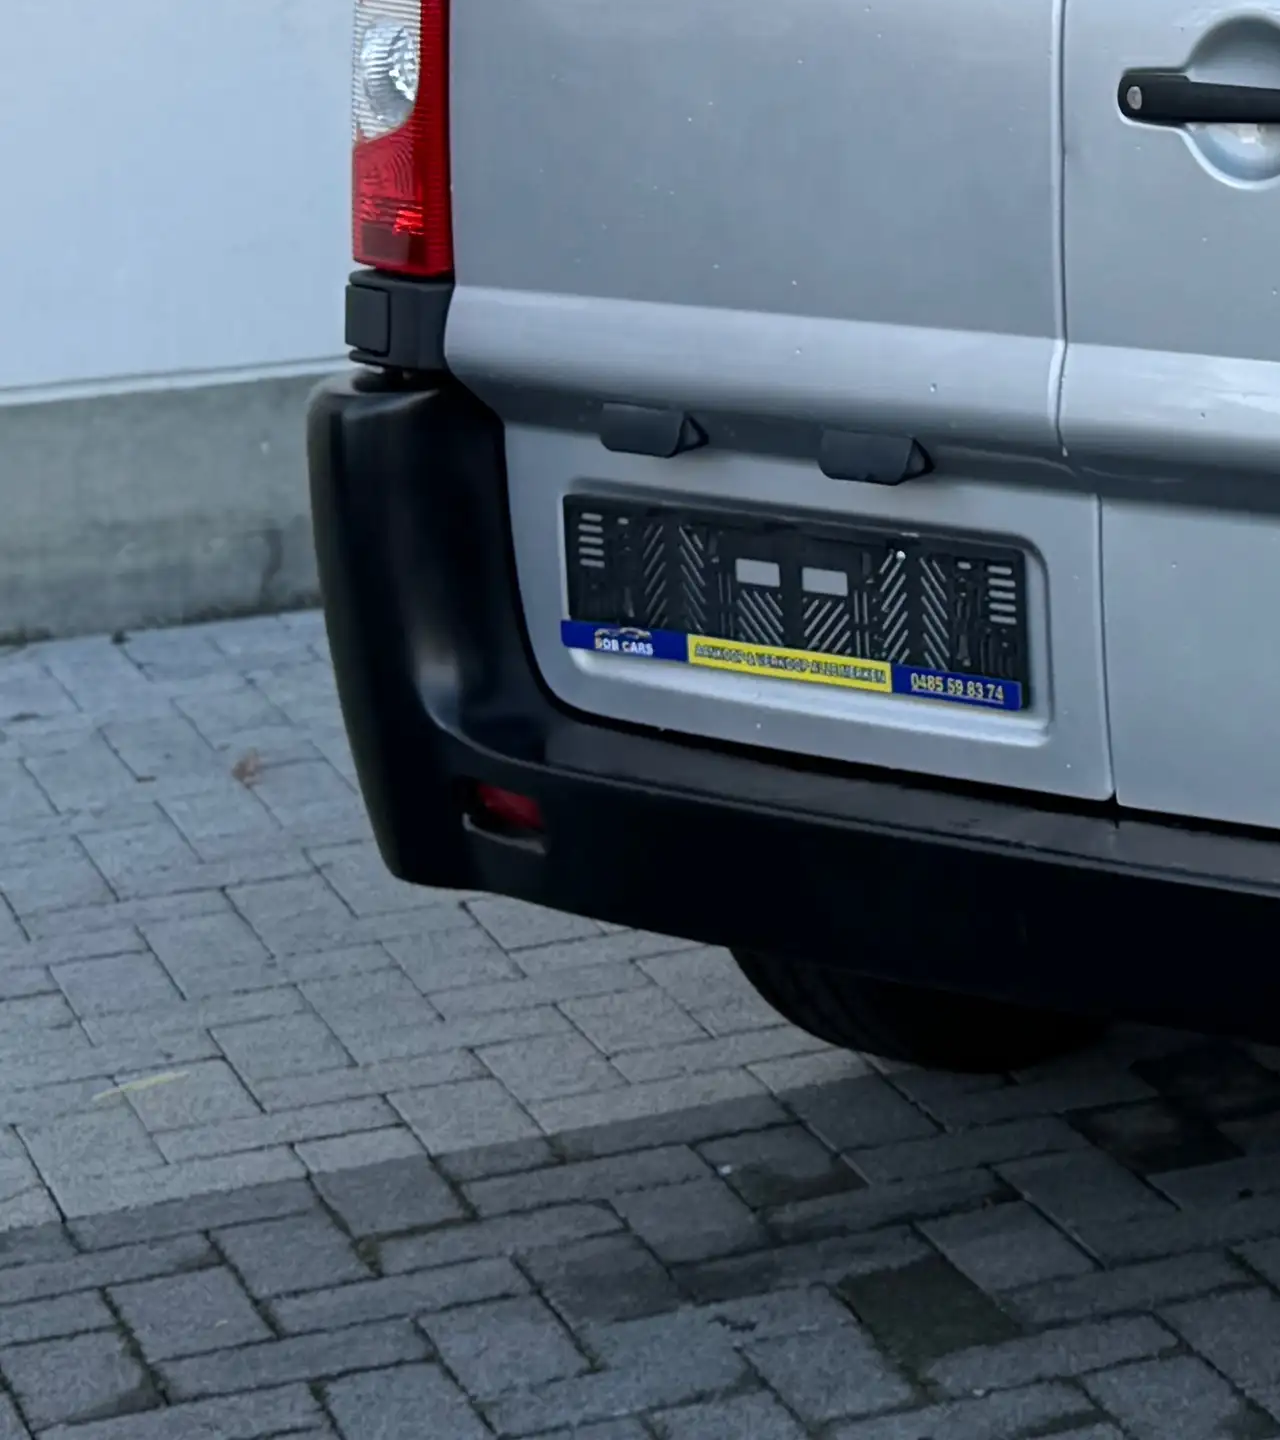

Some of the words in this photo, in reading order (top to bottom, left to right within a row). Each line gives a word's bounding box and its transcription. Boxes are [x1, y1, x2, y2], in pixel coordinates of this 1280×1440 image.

[621, 641, 653, 656] CARS
[911, 673, 943, 692] 0485
[986, 684, 1004, 701] 74
